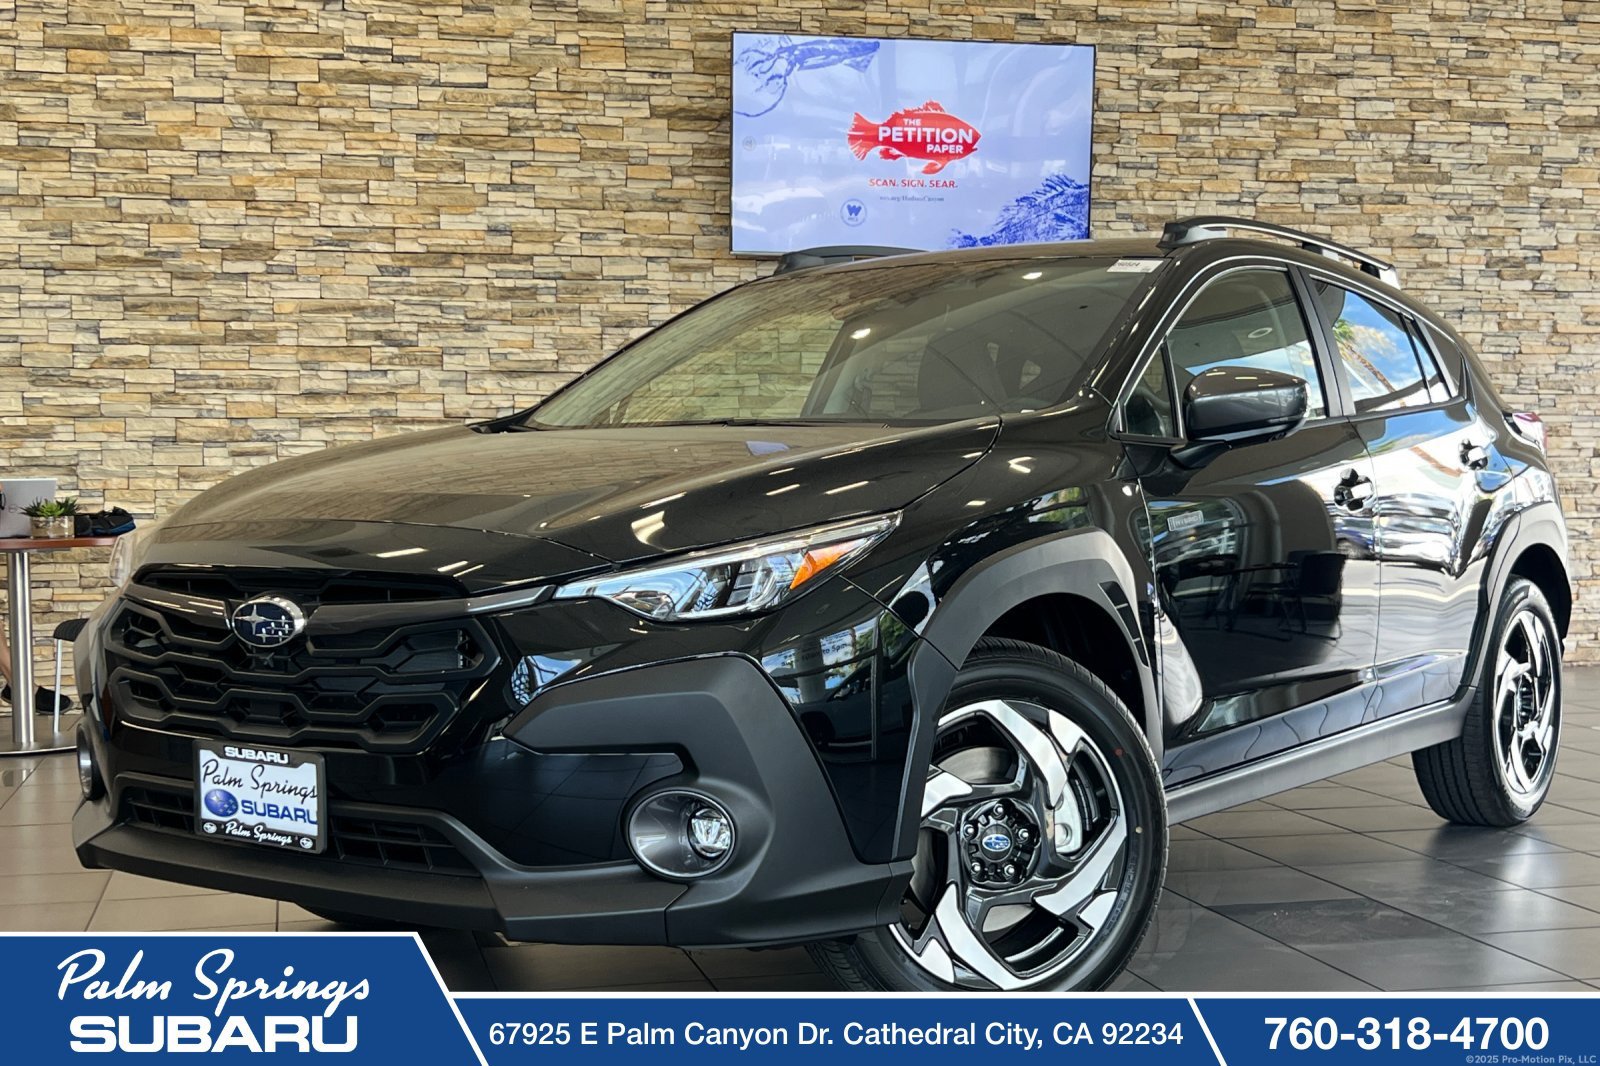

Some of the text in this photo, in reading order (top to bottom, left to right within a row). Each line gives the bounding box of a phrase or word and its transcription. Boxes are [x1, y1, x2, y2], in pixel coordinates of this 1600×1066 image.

[904, 118, 921, 126] THE
[878, 126, 973, 143] PETITION
[926, 144, 963, 154] PAPER
[869, 178, 958, 188] SCAN. SIGN. SEAR.
[224, 747, 289, 764] SUBARU
[202, 758, 318, 805] Palm Springs
[225, 821, 293, 846] Palm Springs
